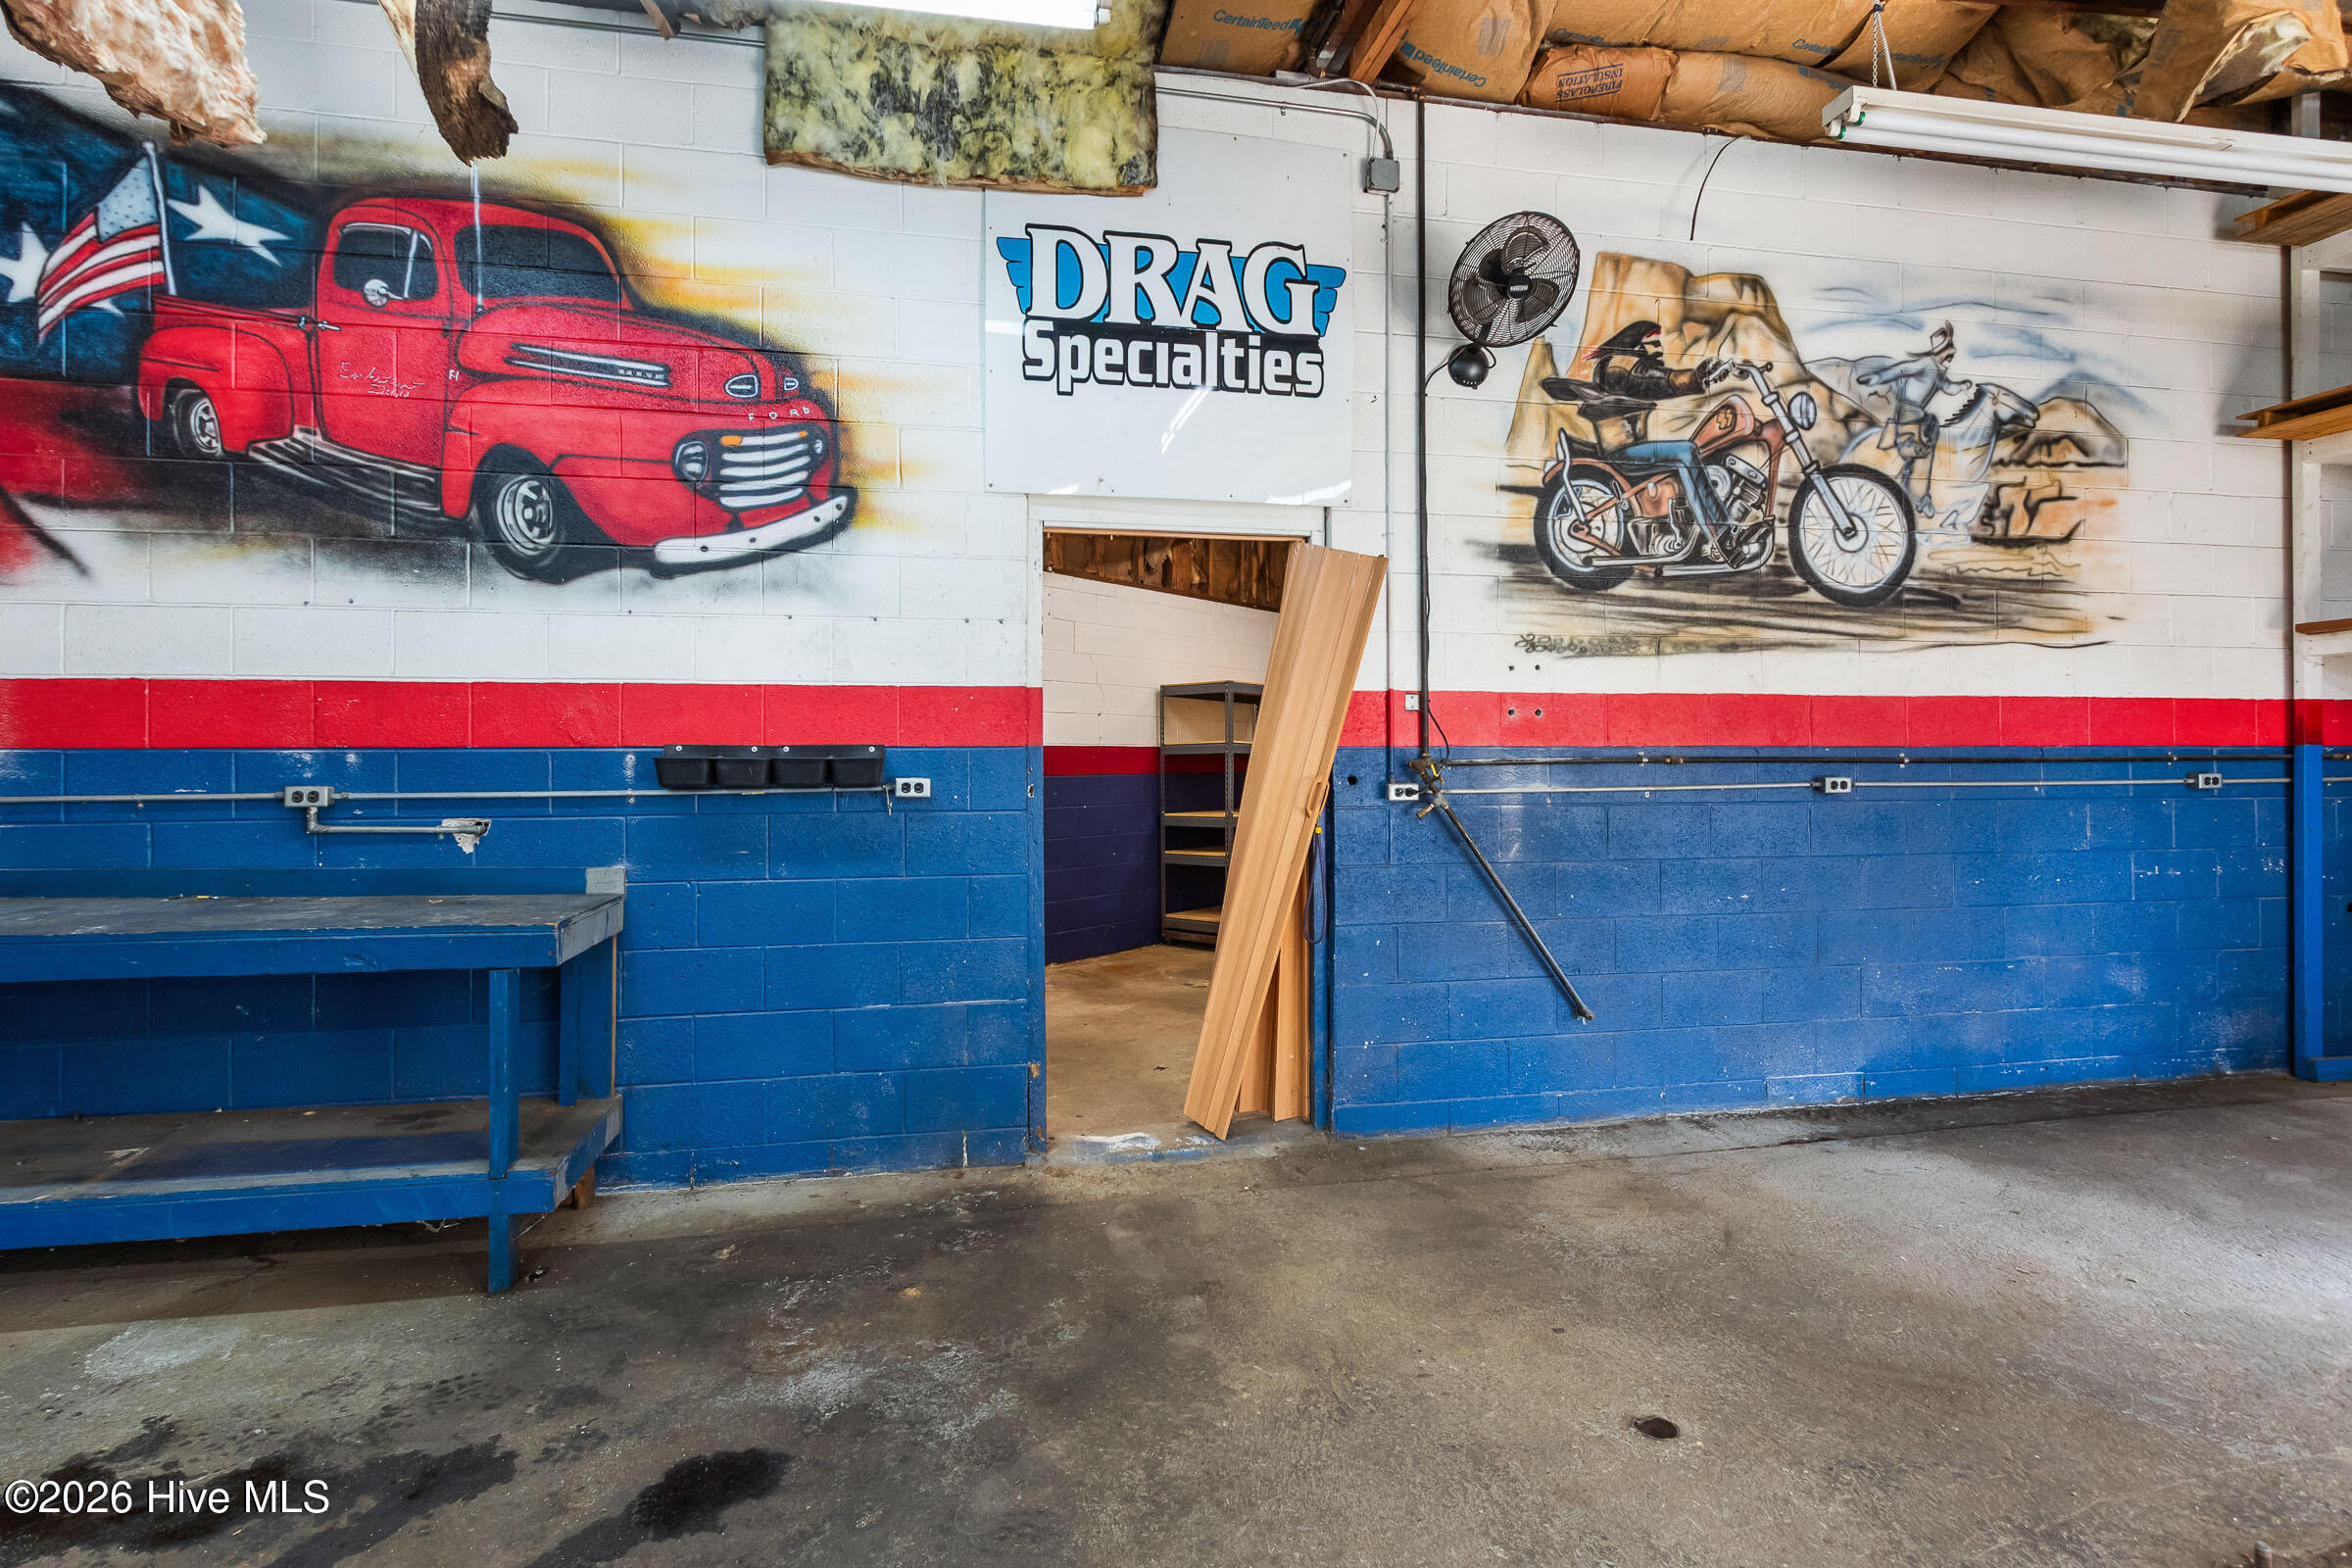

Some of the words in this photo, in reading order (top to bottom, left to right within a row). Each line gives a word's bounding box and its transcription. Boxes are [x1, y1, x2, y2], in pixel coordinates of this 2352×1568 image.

[1213, 9, 1290, 30] CertainTeed
[1413, 47, 1487, 88] CertainTeed
[1557, 68, 1624, 88] INSULATION
[1556, 79, 1623, 99] FIBERGLASS
[1025, 223, 1320, 336] DRAG
[1022, 318, 1324, 398] Specialties
[748, 406, 811, 421] FORD
